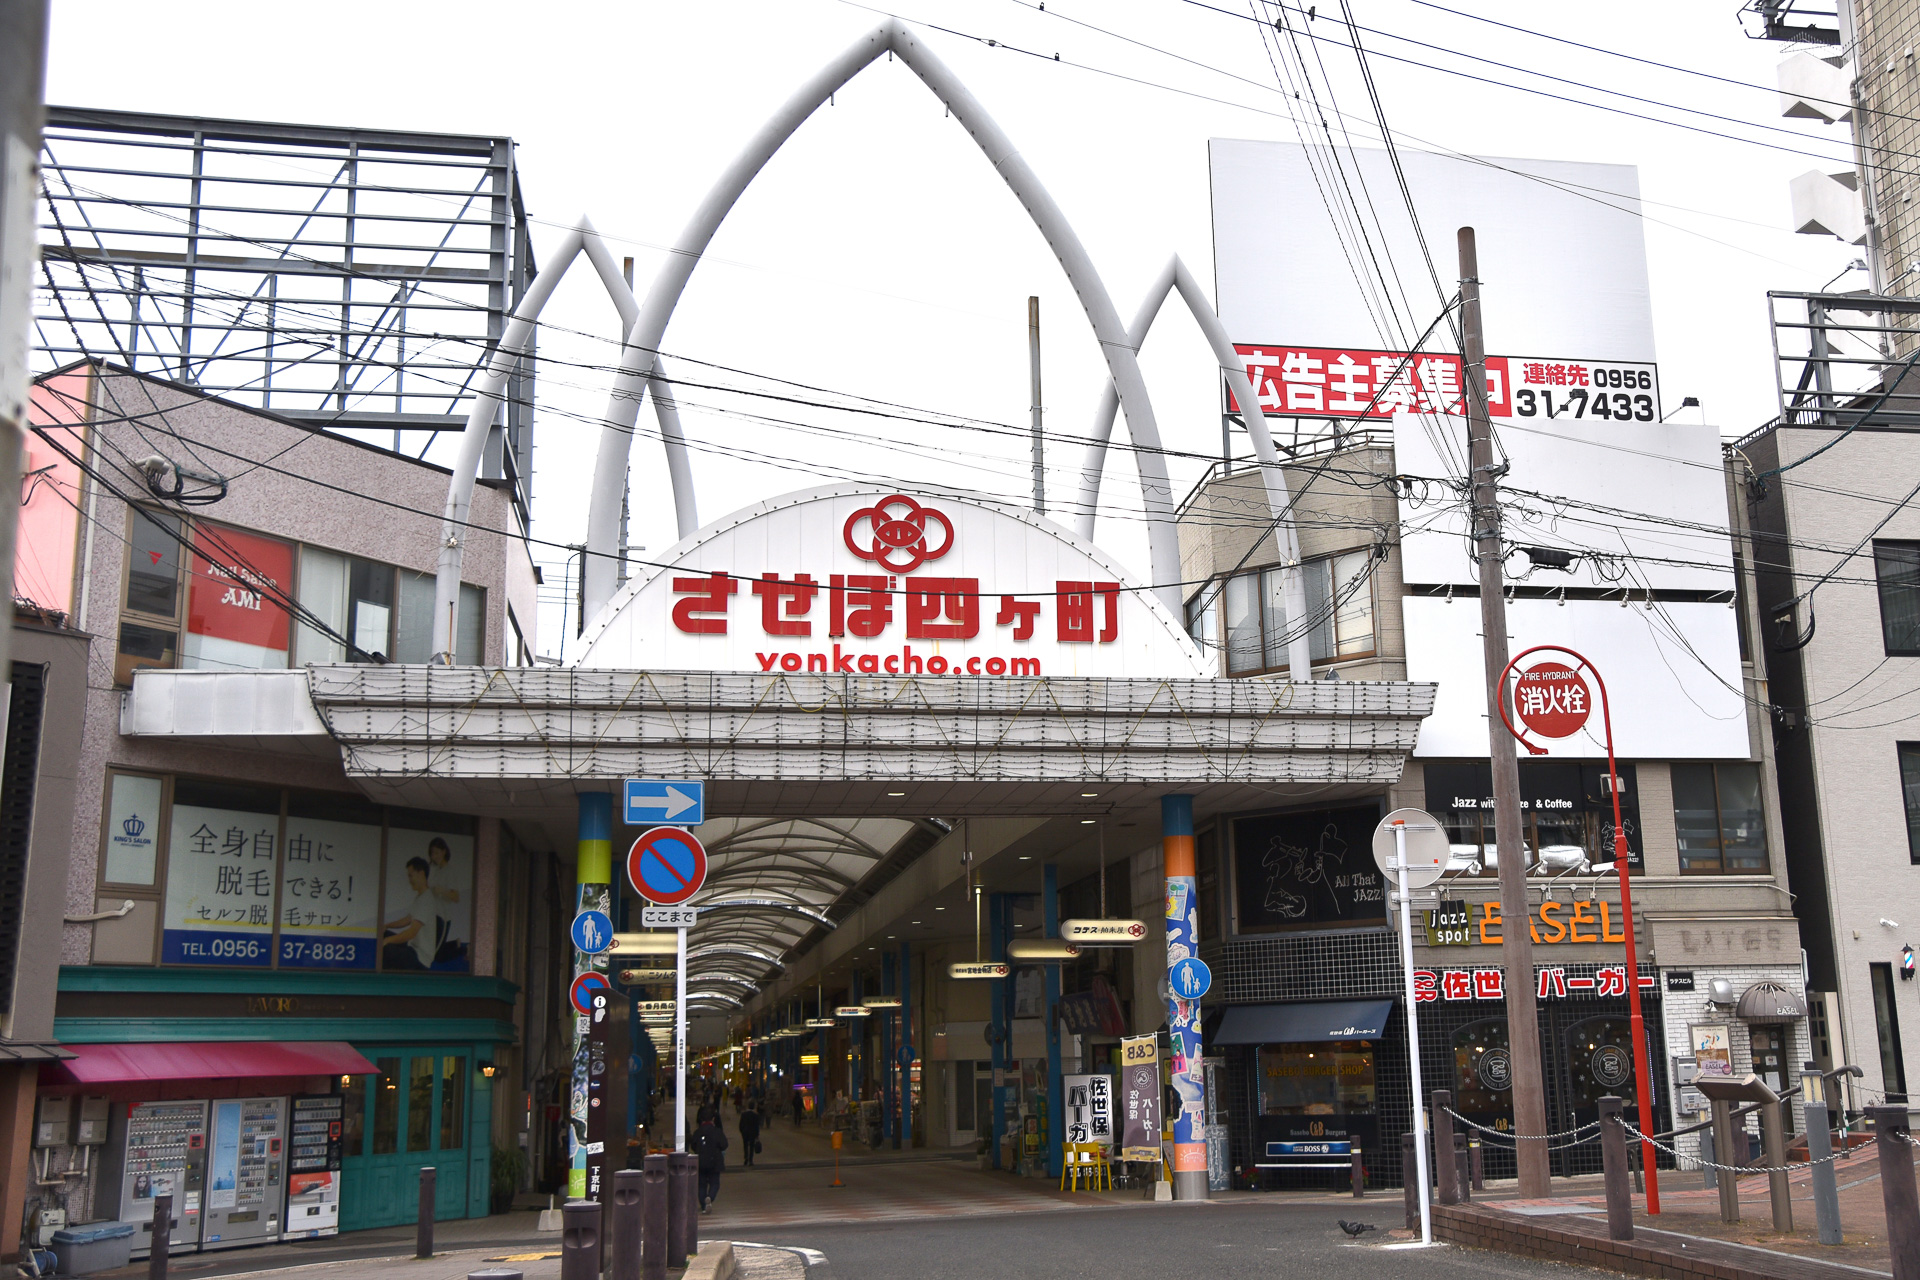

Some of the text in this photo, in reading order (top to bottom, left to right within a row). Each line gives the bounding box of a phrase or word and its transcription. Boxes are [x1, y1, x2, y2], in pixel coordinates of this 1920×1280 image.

[1523, 362, 1652, 389] 連絡先 0956
[1516, 388, 1654, 421] 31-7433
[221, 587, 262, 611] AMI
[671, 571, 1121, 644] させぼ四ヶ町
[755, 644, 1041, 677] yonkacho.com
[1524, 671, 1575, 682] FIRE HYDRANT
[1520, 683, 1587, 716] 消火栓
[1452, 796, 1495, 809] Jazz wit
[1535, 800, 1543, 808] &
[1544, 799, 1573, 809] Coffee
[133, 837, 152, 845] SALON
[189, 823, 334, 863] 全身自由に
[1335, 873, 1377, 888] All That
[1353, 888, 1384, 902] JAZZ!
[196, 904, 350, 927] セルフ脱毛サロン
[645, 911, 694, 923] ここまで
[1431, 909, 1468, 928] jazz
[1437, 927, 1470, 944] spot
[1443, 966, 1656, 1001] 佐世バーガー
[1776, 1007, 1800, 1015] EASEL
[1267, 1064, 1364, 1077] SASEBO BURGER SHOP
[1090, 1077, 1109, 1136] 佐世保
[1289, 1120, 1347, 1137] Sasebo C&B Burgers
[1304, 1145, 1321, 1153] BOSS
[590, 1165, 601, 1193] 下京町
